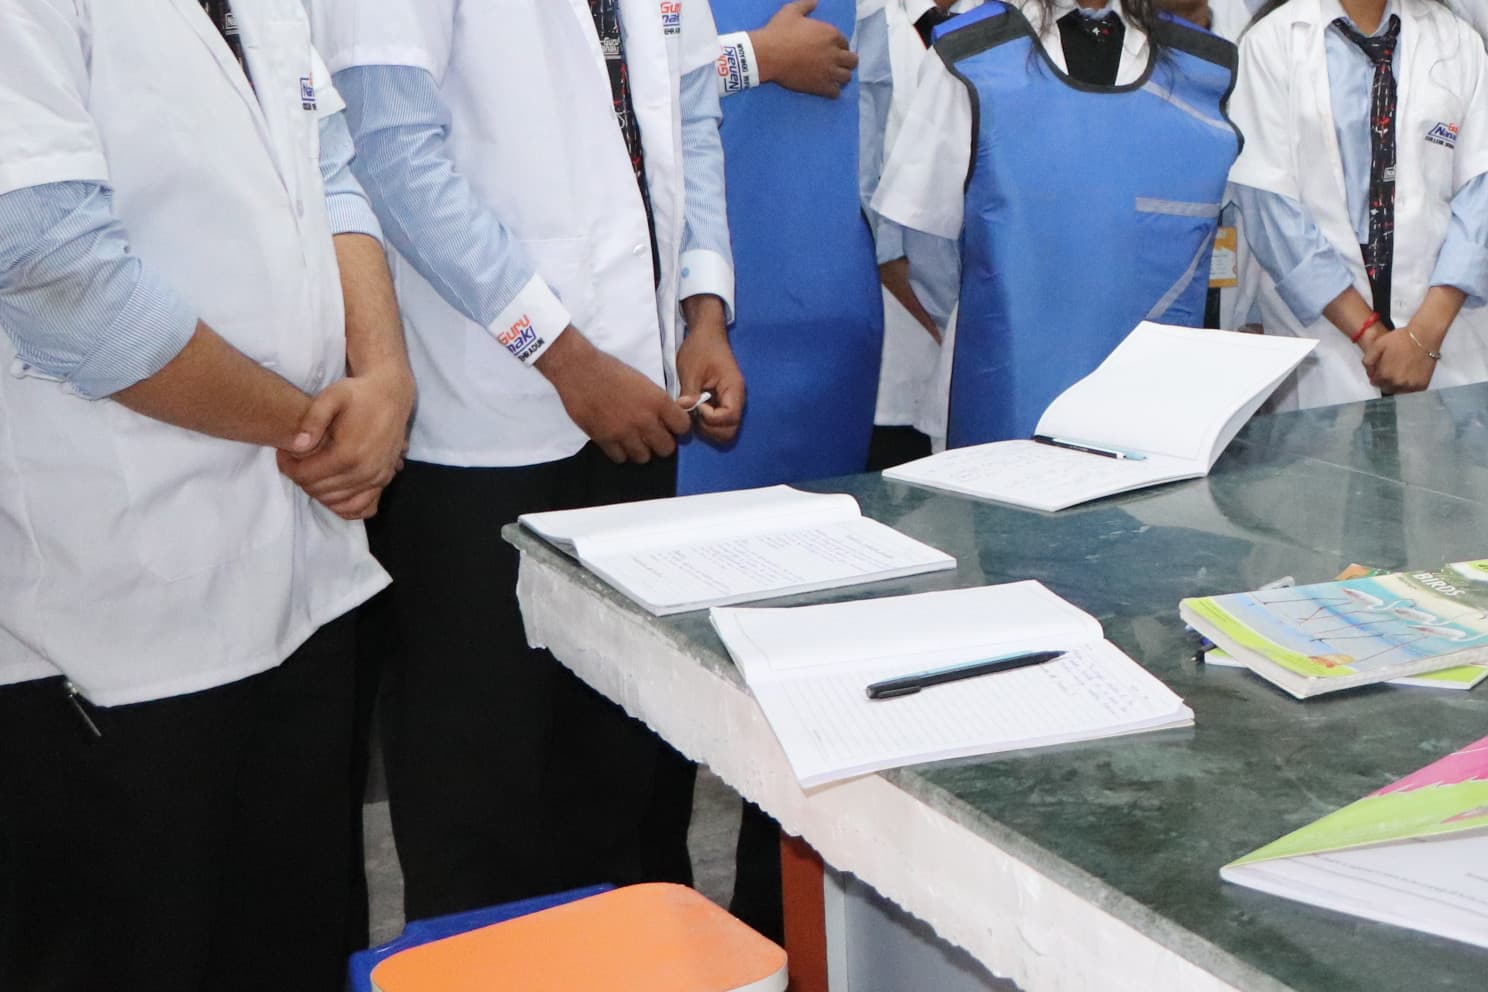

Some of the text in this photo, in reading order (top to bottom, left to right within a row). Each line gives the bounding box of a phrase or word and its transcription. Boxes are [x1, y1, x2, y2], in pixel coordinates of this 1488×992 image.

[723, 49, 740, 90] Nanak
[496, 313, 530, 346] Guru
[1413, 572, 1467, 597] BIRDS
